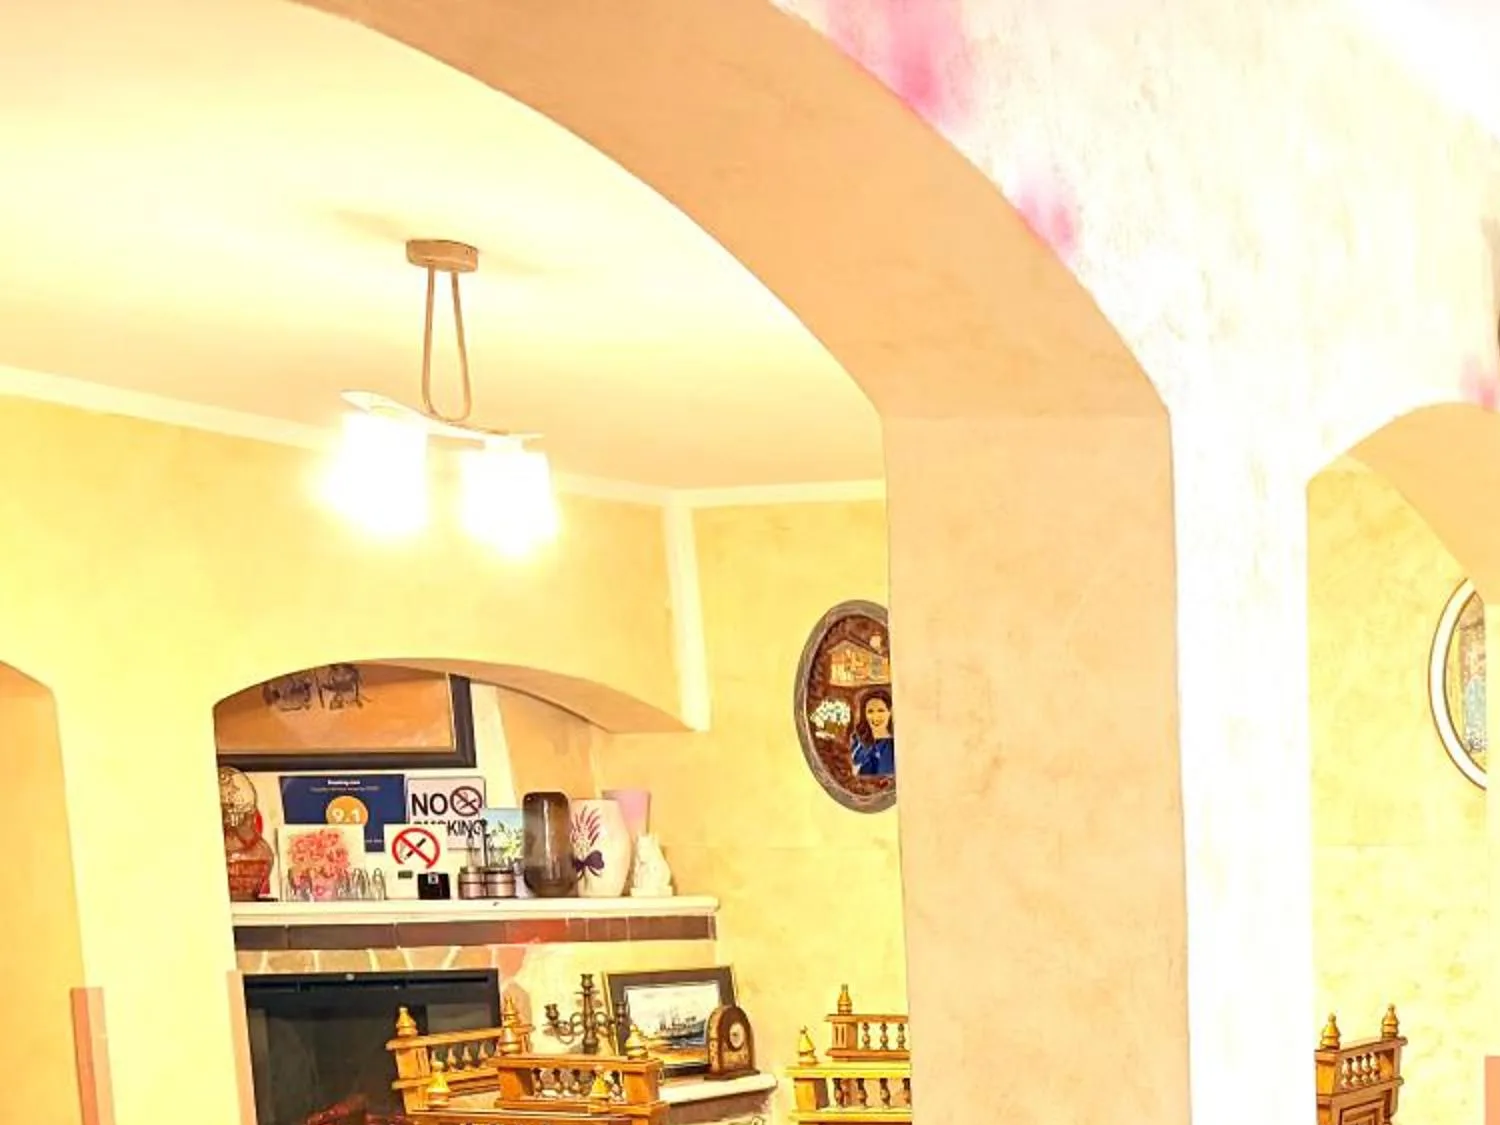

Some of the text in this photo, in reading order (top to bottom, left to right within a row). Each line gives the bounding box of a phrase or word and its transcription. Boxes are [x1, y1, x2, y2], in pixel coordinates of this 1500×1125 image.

[411, 793, 448, 816] NO
[331, 807, 361, 823] 9.1
[413, 819, 484, 836] KING
